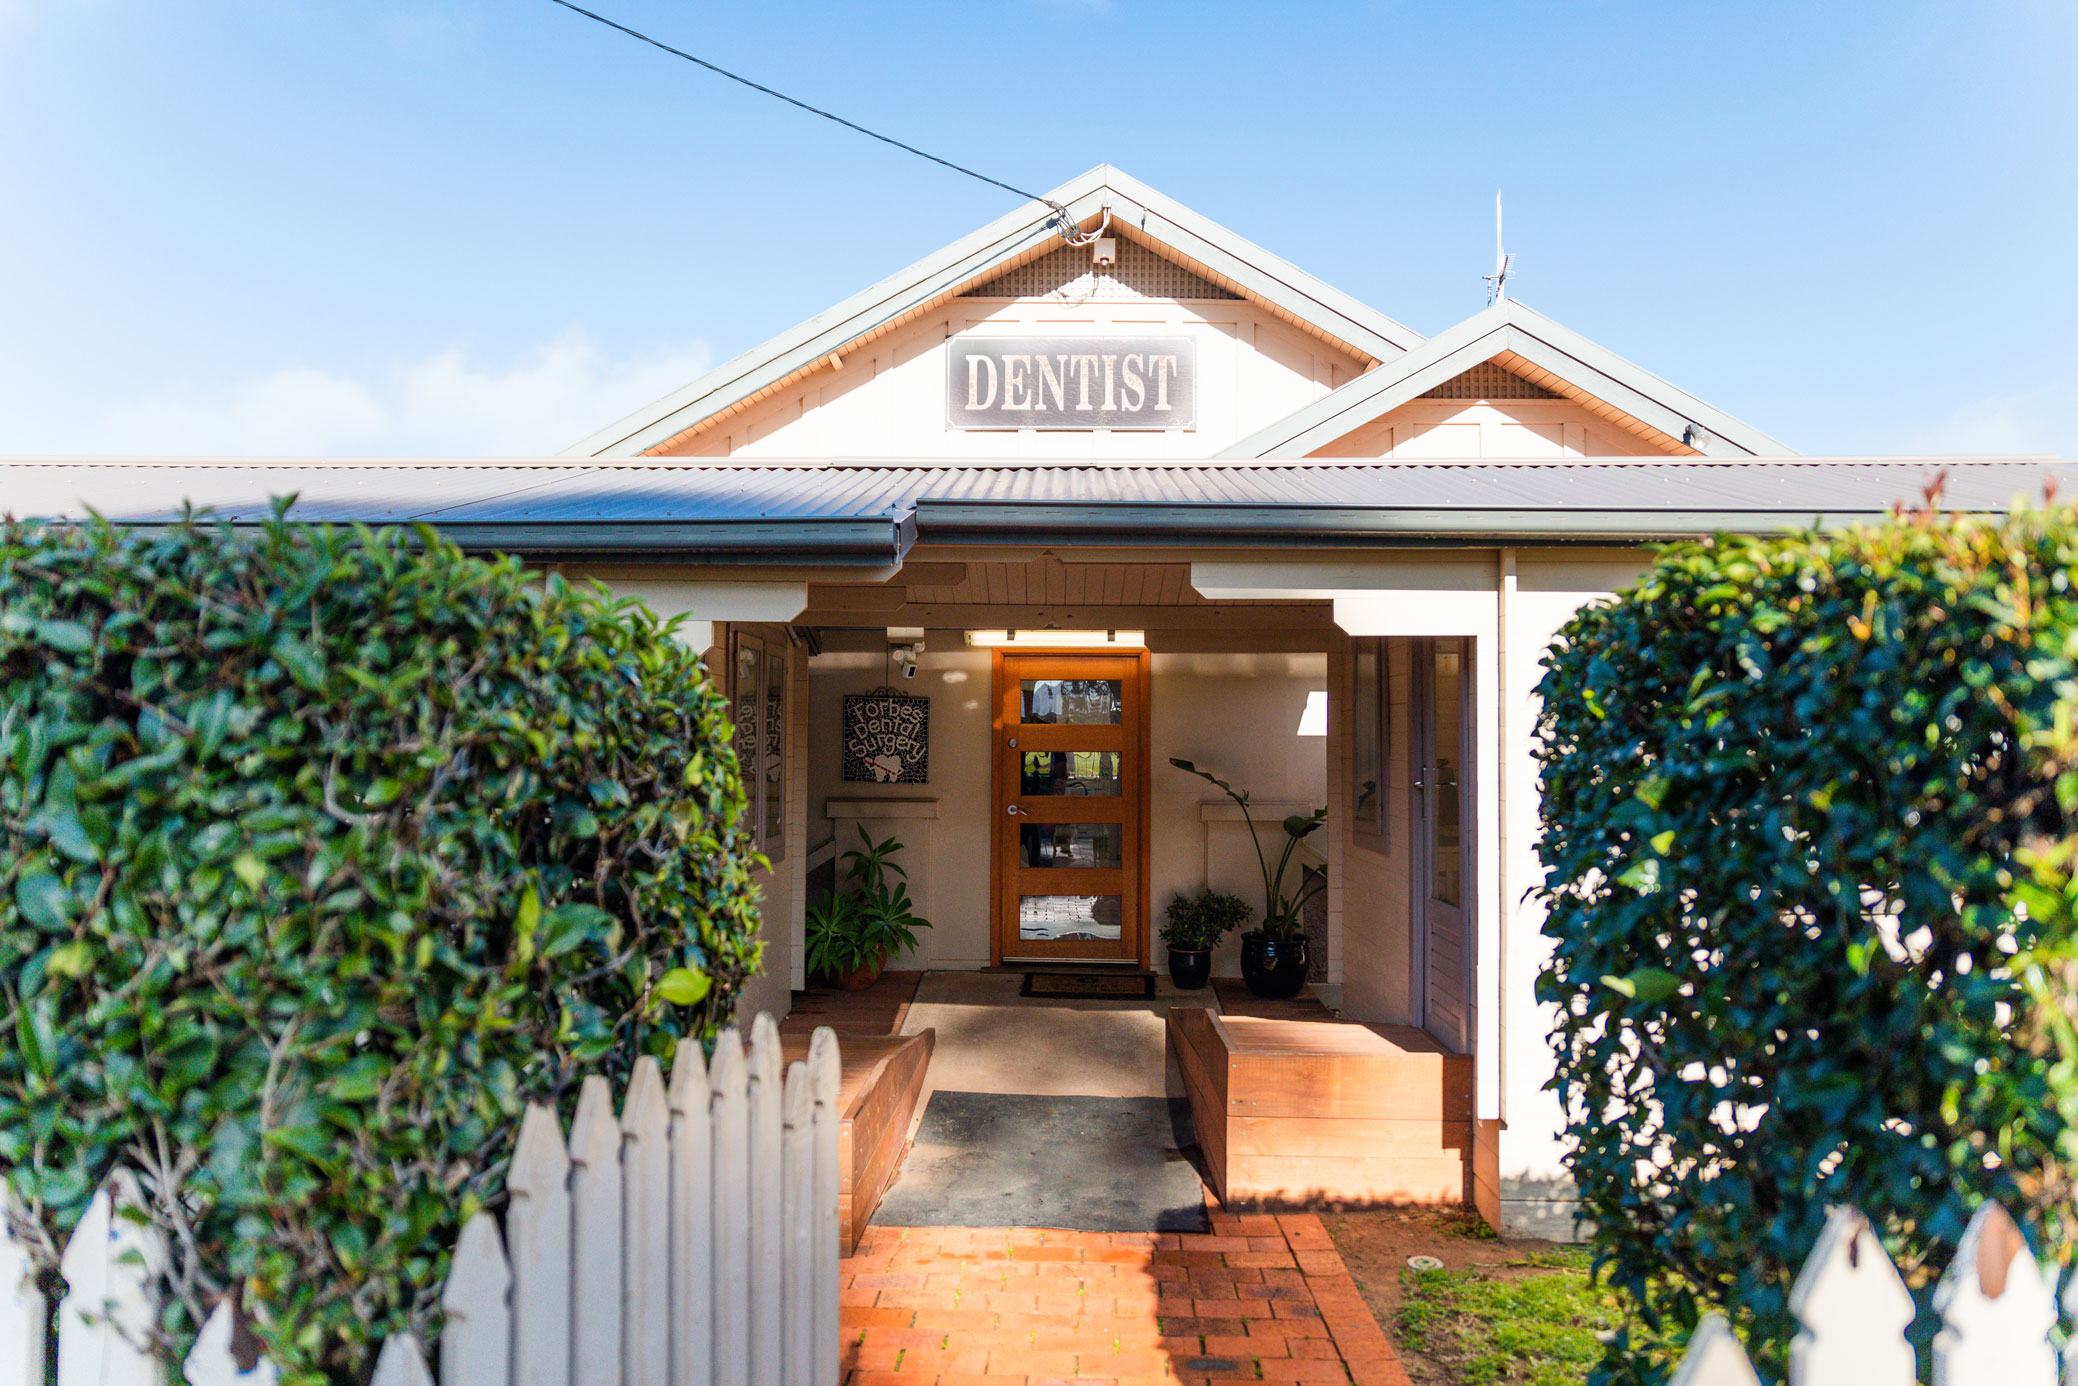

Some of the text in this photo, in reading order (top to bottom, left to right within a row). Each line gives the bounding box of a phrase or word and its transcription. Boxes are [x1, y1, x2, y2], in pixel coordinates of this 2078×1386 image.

[965, 353, 1177, 412] DENTIST
[854, 698, 923, 723] Forbes
[854, 716, 920, 739] Dental
[848, 734, 926, 763] Surgery
